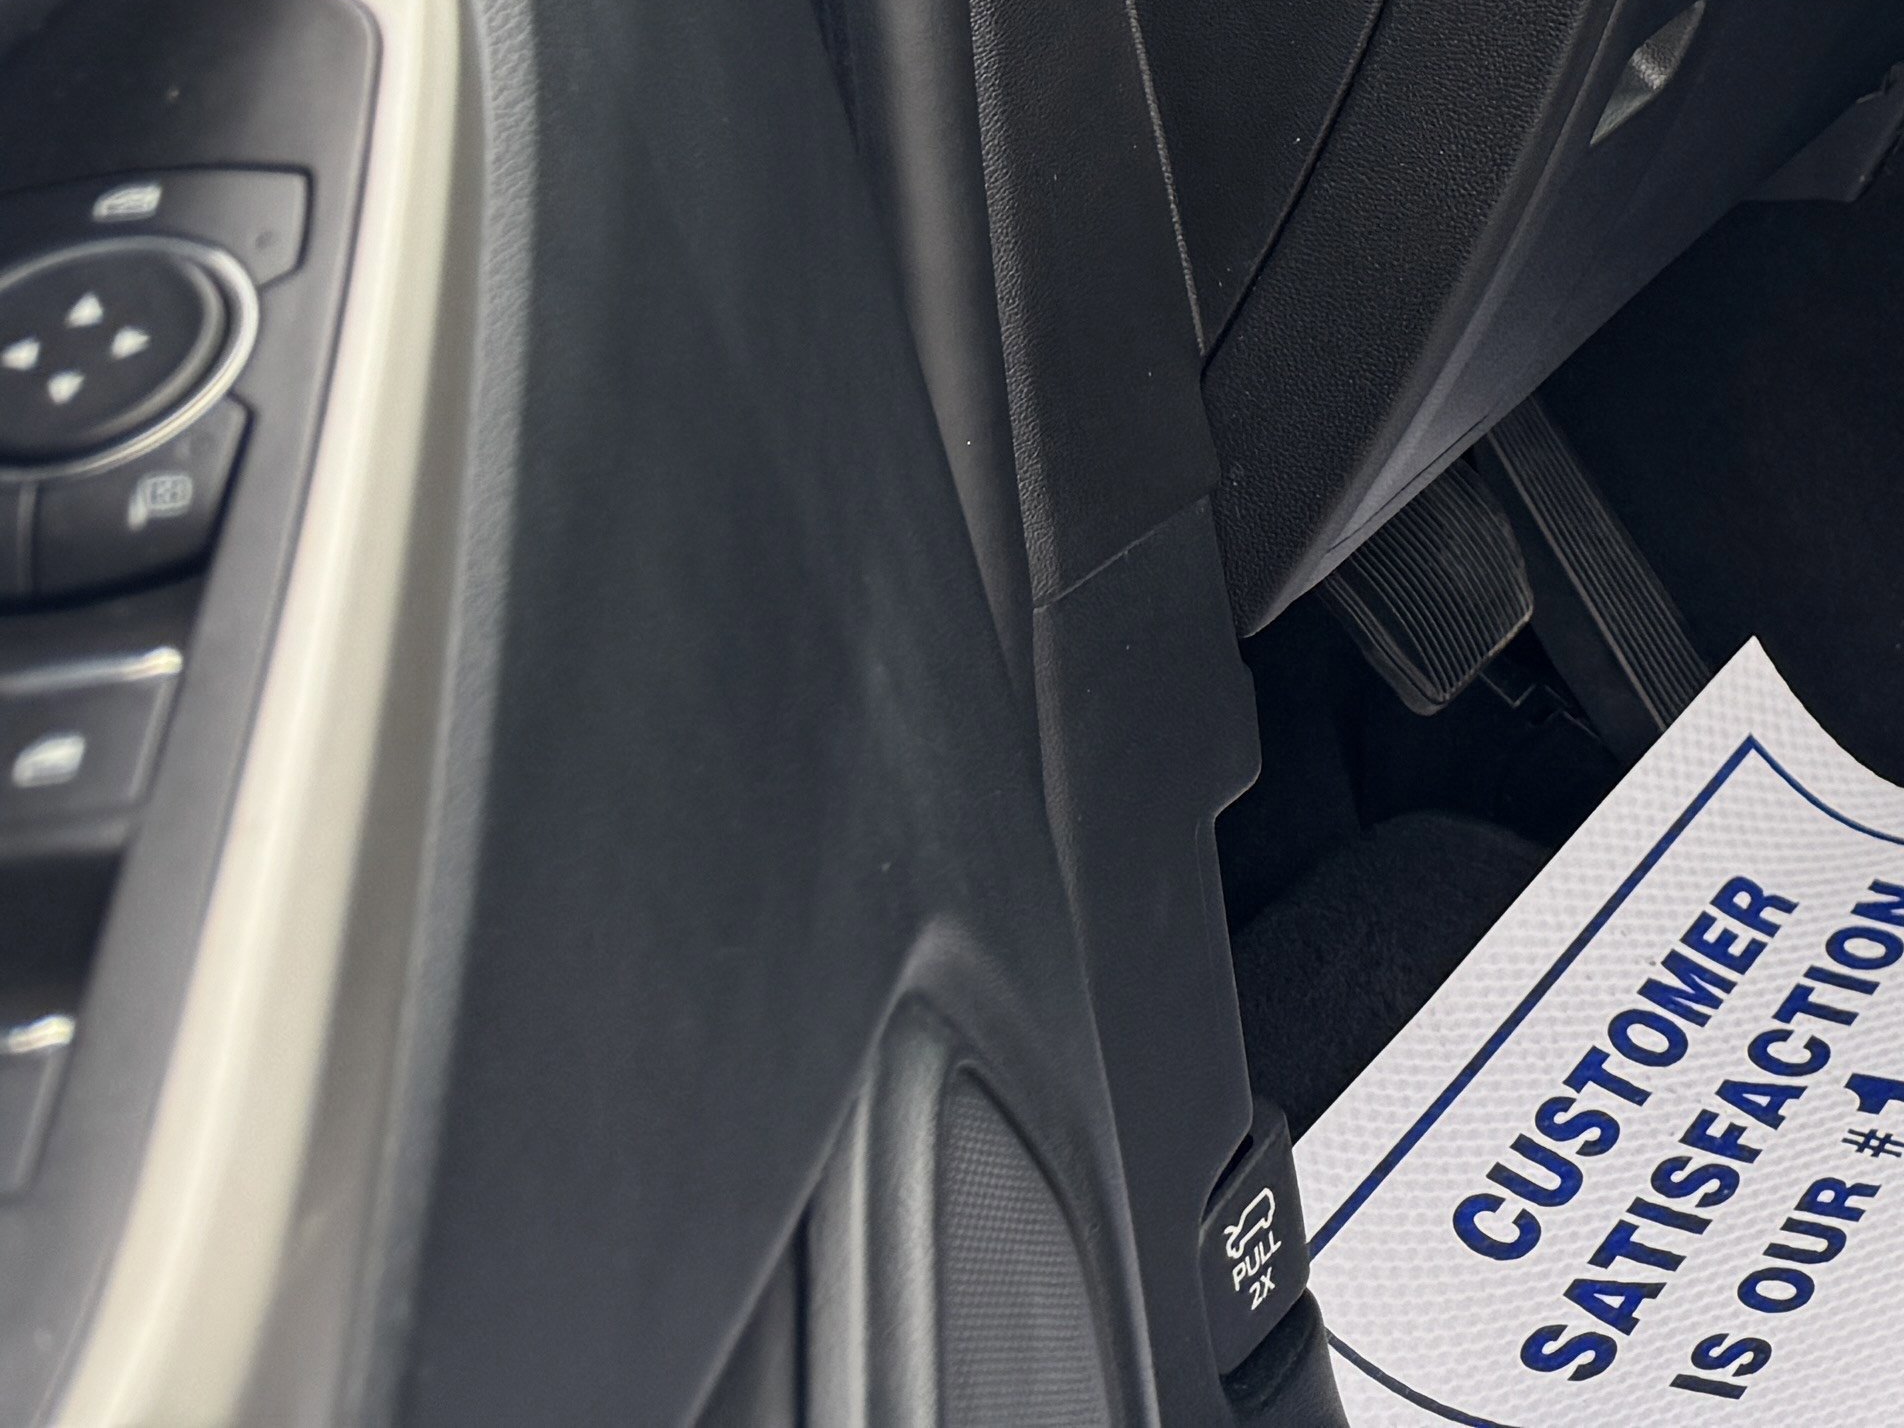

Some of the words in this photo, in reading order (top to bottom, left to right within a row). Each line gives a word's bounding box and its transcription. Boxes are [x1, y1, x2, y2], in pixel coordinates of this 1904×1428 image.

[1452, 875, 1800, 1261] CUSTOMER
[1232, 1230, 1282, 1291] PULL
[1249, 1266, 1275, 1310] 2X
[1669, 1333, 1773, 1400] IS
[1737, 1176, 1882, 1314] OUR
